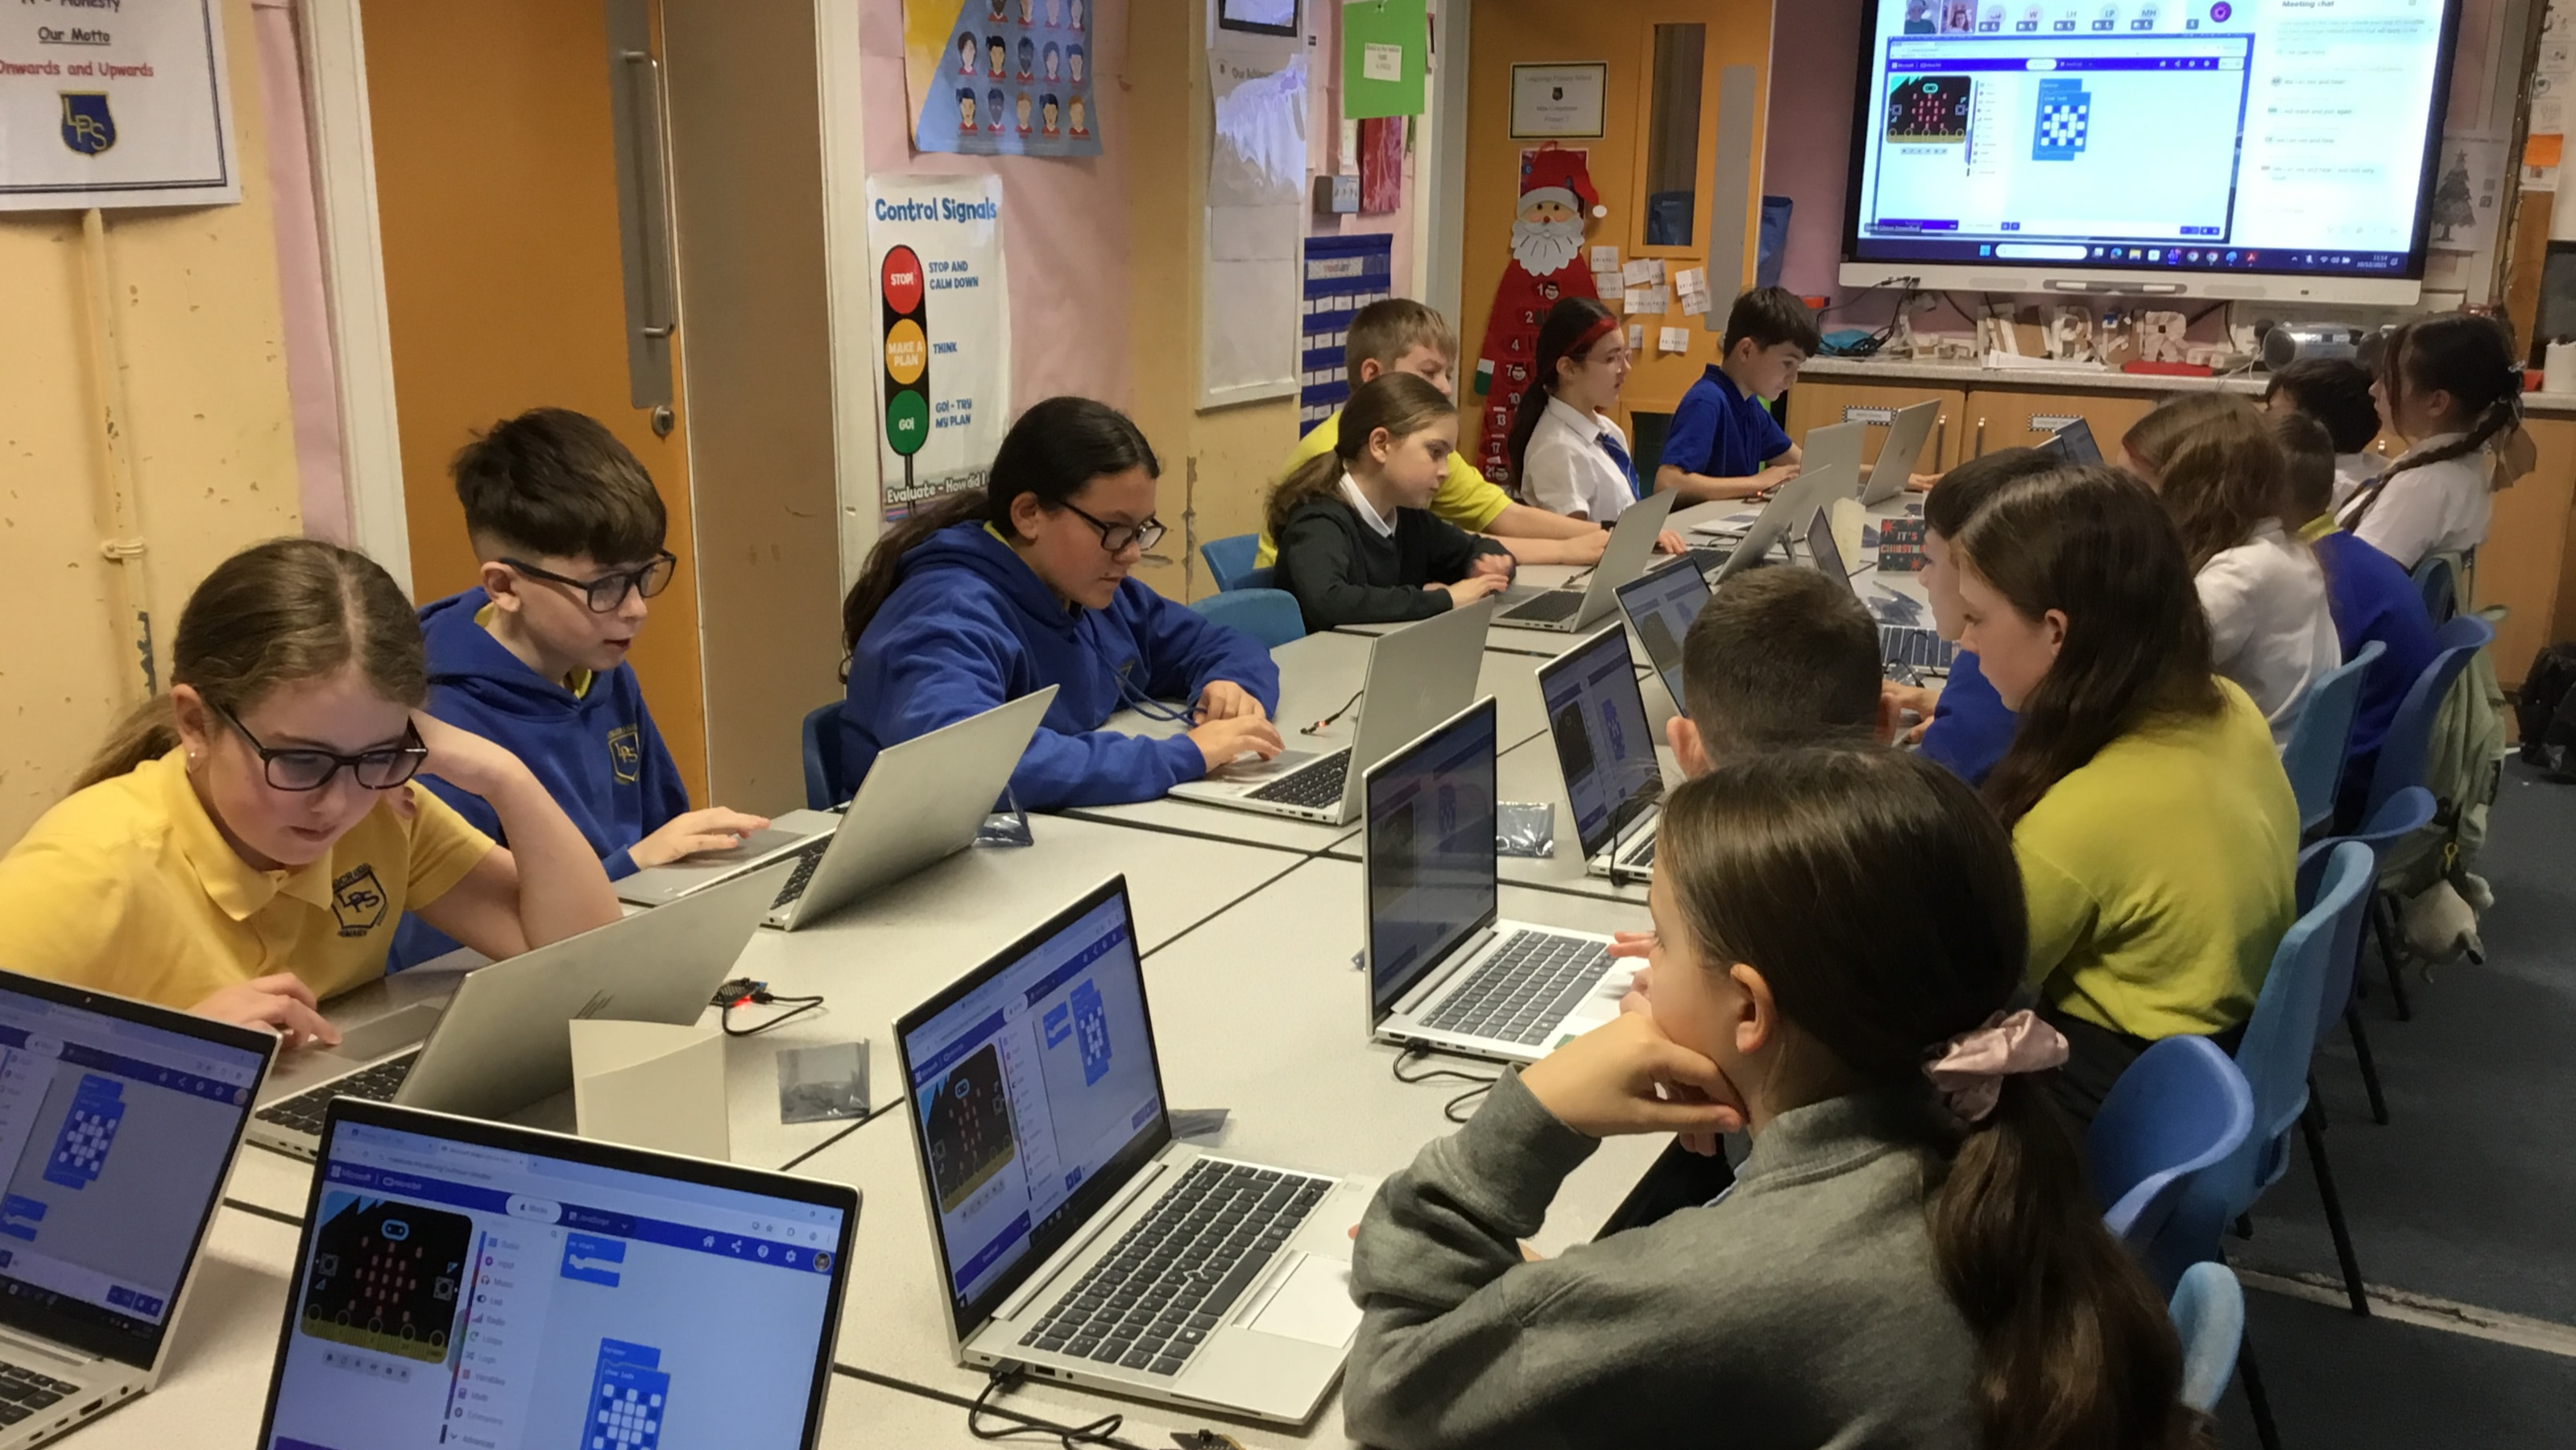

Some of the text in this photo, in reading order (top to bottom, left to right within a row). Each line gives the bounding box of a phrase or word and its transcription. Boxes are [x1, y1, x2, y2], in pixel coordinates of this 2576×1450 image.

[38, 27, 110, 42] Our Motto
[0, 60, 154, 80] Onwards and Upwards
[64, 96, 107, 151] LPS
[876, 197, 997, 224] Control Signals
[929, 261, 968, 273] STOP AND
[890, 272, 914, 286] STOP!
[930, 276, 979, 290] CALM DOWN
[1538, 284, 1543, 296] 1
[1526, 311, 1533, 323] 2
[888, 341, 923, 354] MAKE A
[933, 342, 957, 354] THINK
[1511, 338, 1520, 351] 4
[894, 354, 918, 367] PLAN
[1506, 365, 1512, 377] 7
[935, 400, 949, 412] GO!
[956, 398, 971, 410] TRY
[1509, 393, 1521, 404] 10
[899, 417, 914, 430] GO!
[936, 414, 971, 428] MY PLAN
[1497, 415, 1506, 426] 13
[1492, 443, 1501, 454] 17
[887, 485, 936, 503] Evaluate
[946, 478, 967, 493] How
[967, 474, 980, 488] did
[1897, 531, 1918, 541] IT'S
[1881, 544, 1925, 553] CHRISTMA
[338, 890, 379, 913] LPS
[474, 1373, 506, 1386] Variables
